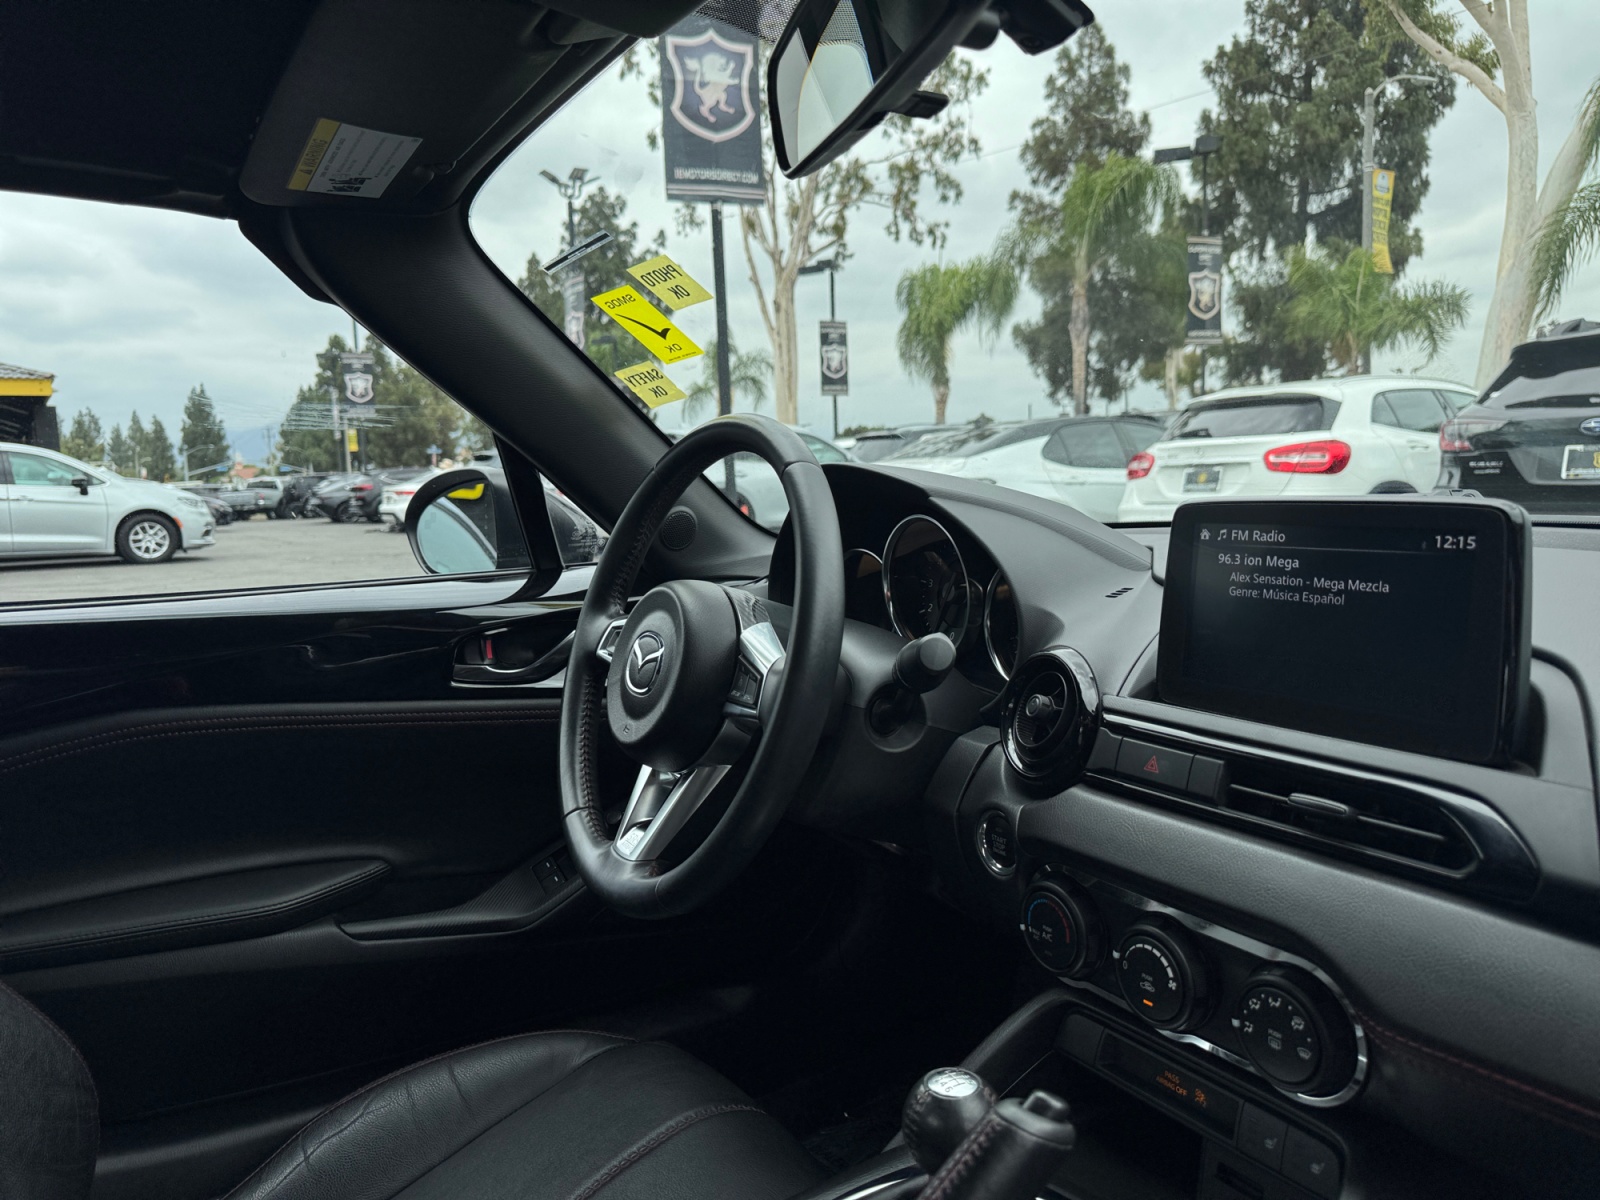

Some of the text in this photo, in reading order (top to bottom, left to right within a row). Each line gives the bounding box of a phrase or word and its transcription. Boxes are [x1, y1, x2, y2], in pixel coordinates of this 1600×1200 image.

[1231, 530, 1286, 543] FM Radio
[1434, 535, 1477, 549] 12:15
[1218, 553, 1300, 570] 96.3 ion Mega
[1230, 571, 1250, 584] Alex
[1253, 573, 1303, 587] Sensation
[1313, 577, 1345, 591] Mega
[1347, 579, 1390, 593] Mezcla
[1229, 586, 1345, 606] Genre: Música Español
[1164, 1070, 1181, 1084] PASS
[1175, 1085, 1188, 1096] OFF
